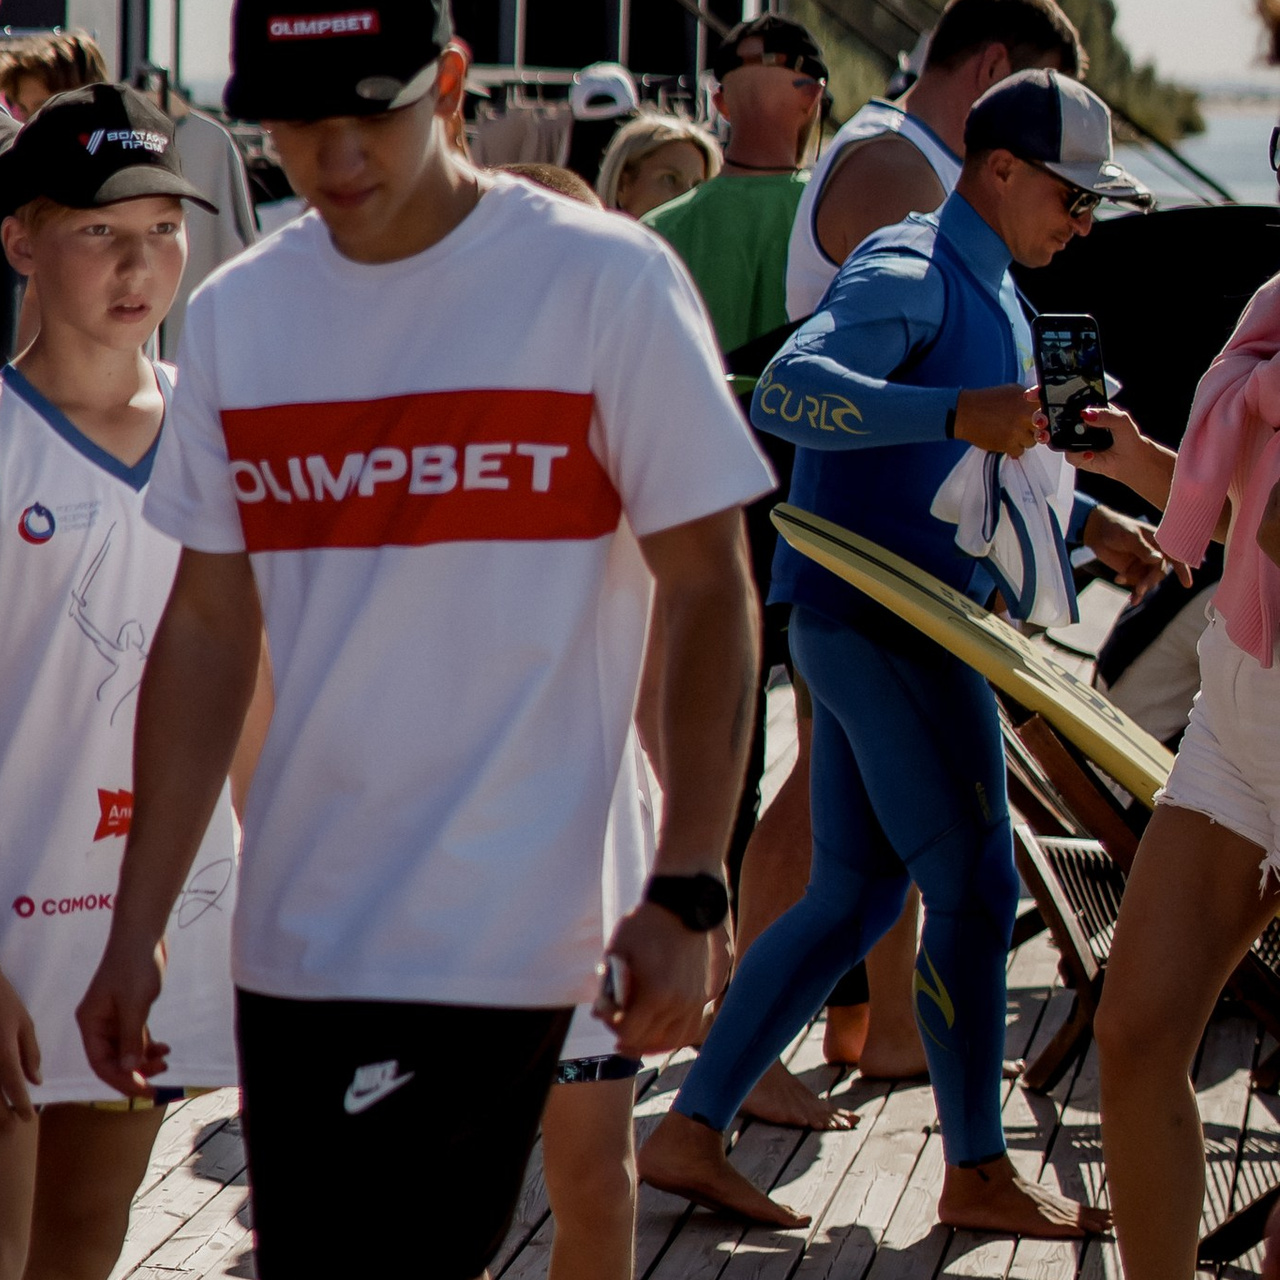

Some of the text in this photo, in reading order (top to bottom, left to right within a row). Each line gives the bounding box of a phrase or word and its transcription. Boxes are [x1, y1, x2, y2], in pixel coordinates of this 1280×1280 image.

[270, 14, 372, 36] OLIMPBET
[228, 441, 569, 505] OLIMPBET
[41, 892, 117, 917] самок
